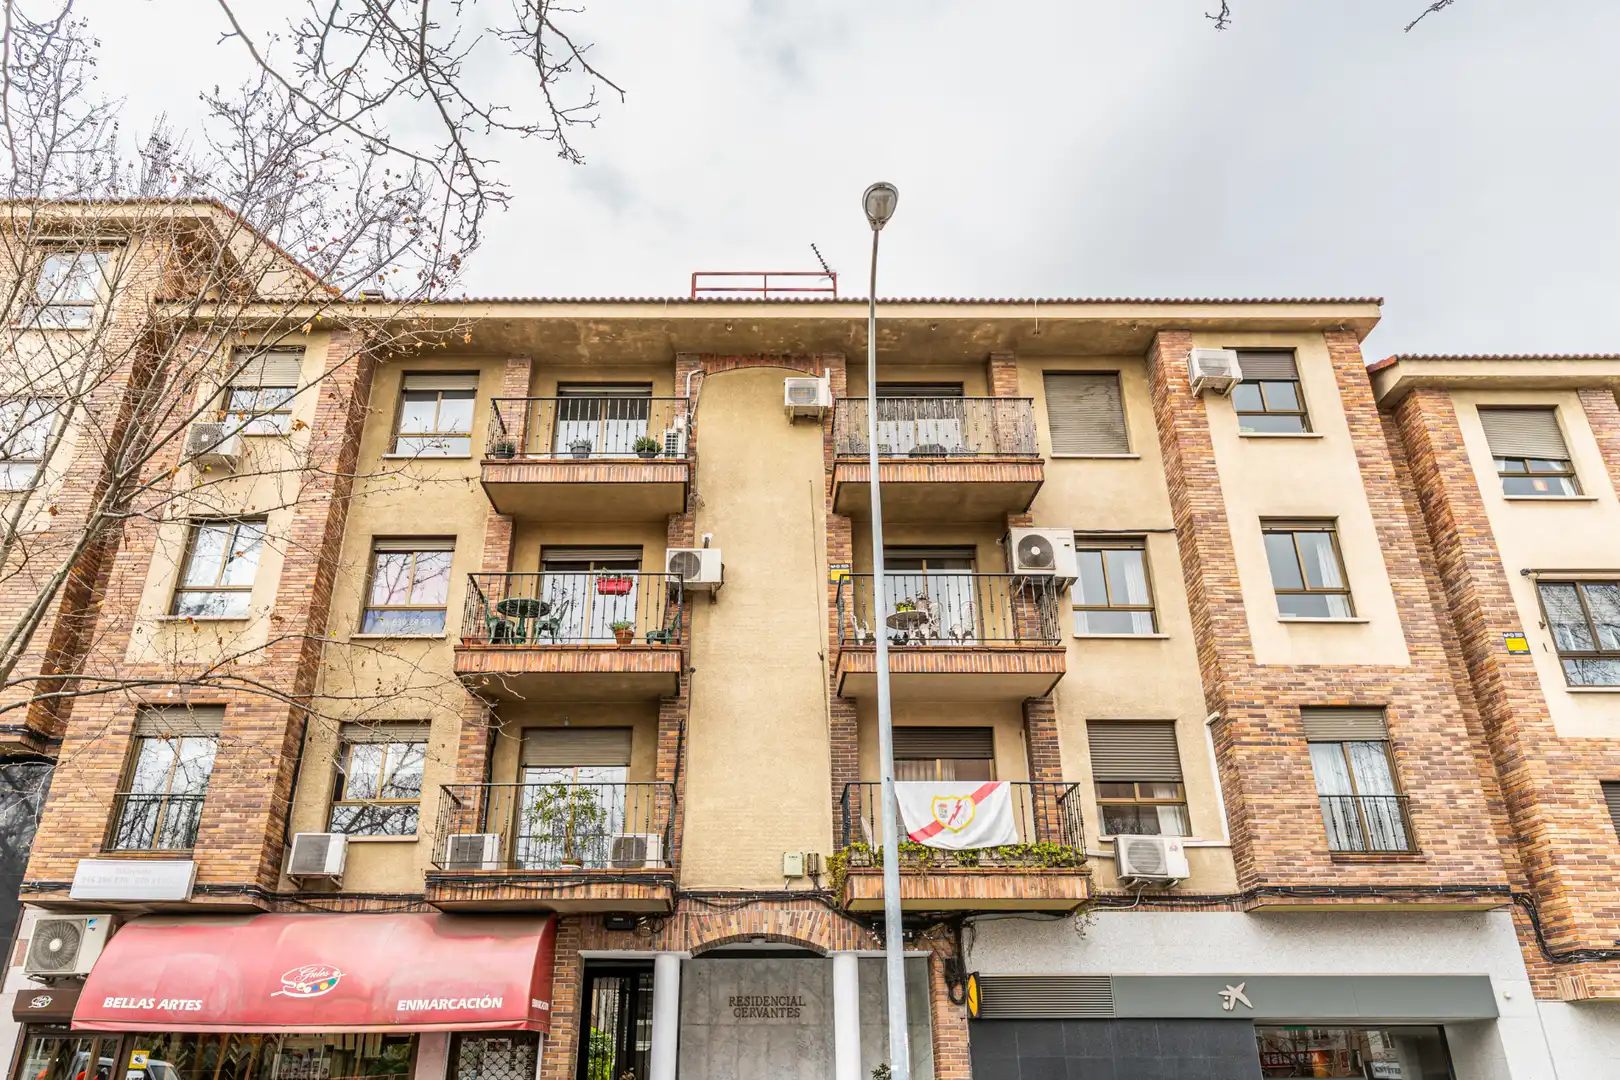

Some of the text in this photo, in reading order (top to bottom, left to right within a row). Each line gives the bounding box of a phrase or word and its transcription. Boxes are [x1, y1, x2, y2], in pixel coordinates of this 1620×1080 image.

[102, 997, 203, 1011] BELLAS ARTES
[397, 994, 504, 1011] ENMARCACIÓN
[728, 995, 807, 1007] RESIDENCIAL
[733, 1007, 801, 1018] CERVANTES
